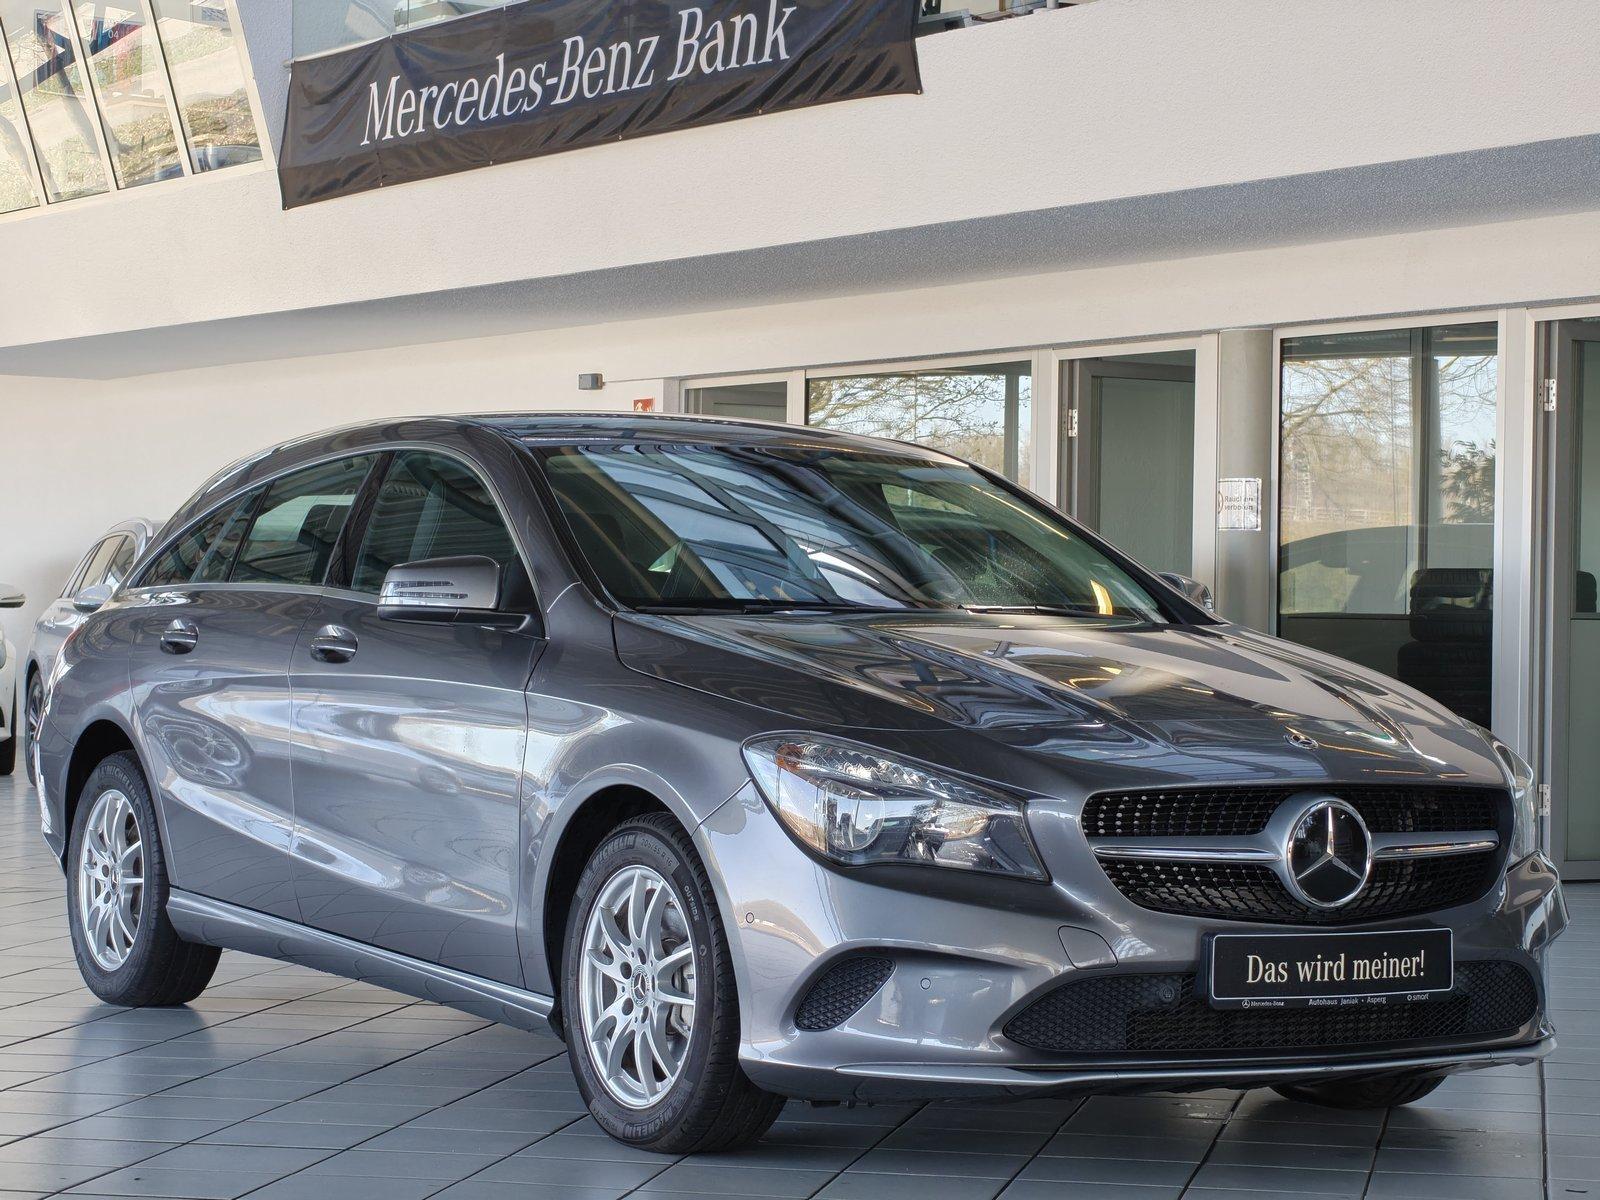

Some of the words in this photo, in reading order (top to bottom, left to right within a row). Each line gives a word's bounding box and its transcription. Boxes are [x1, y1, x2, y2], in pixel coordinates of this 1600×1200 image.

[360, 35, 660, 146] Mercedes-Benz
[667, 0, 797, 82] Bank
[592, 833, 637, 868] MICHELIN
[684, 885, 700, 921] OUTSIDE
[1246, 954, 1289, 984] Das
[1296, 952, 1346, 982] wird
[1352, 949, 1425, 980] meiner!
[1308, 998, 1338, 1006] Autohaus
[1366, 996, 1387, 1005] Asperg
[1412, 992, 1430, 1001] smart
